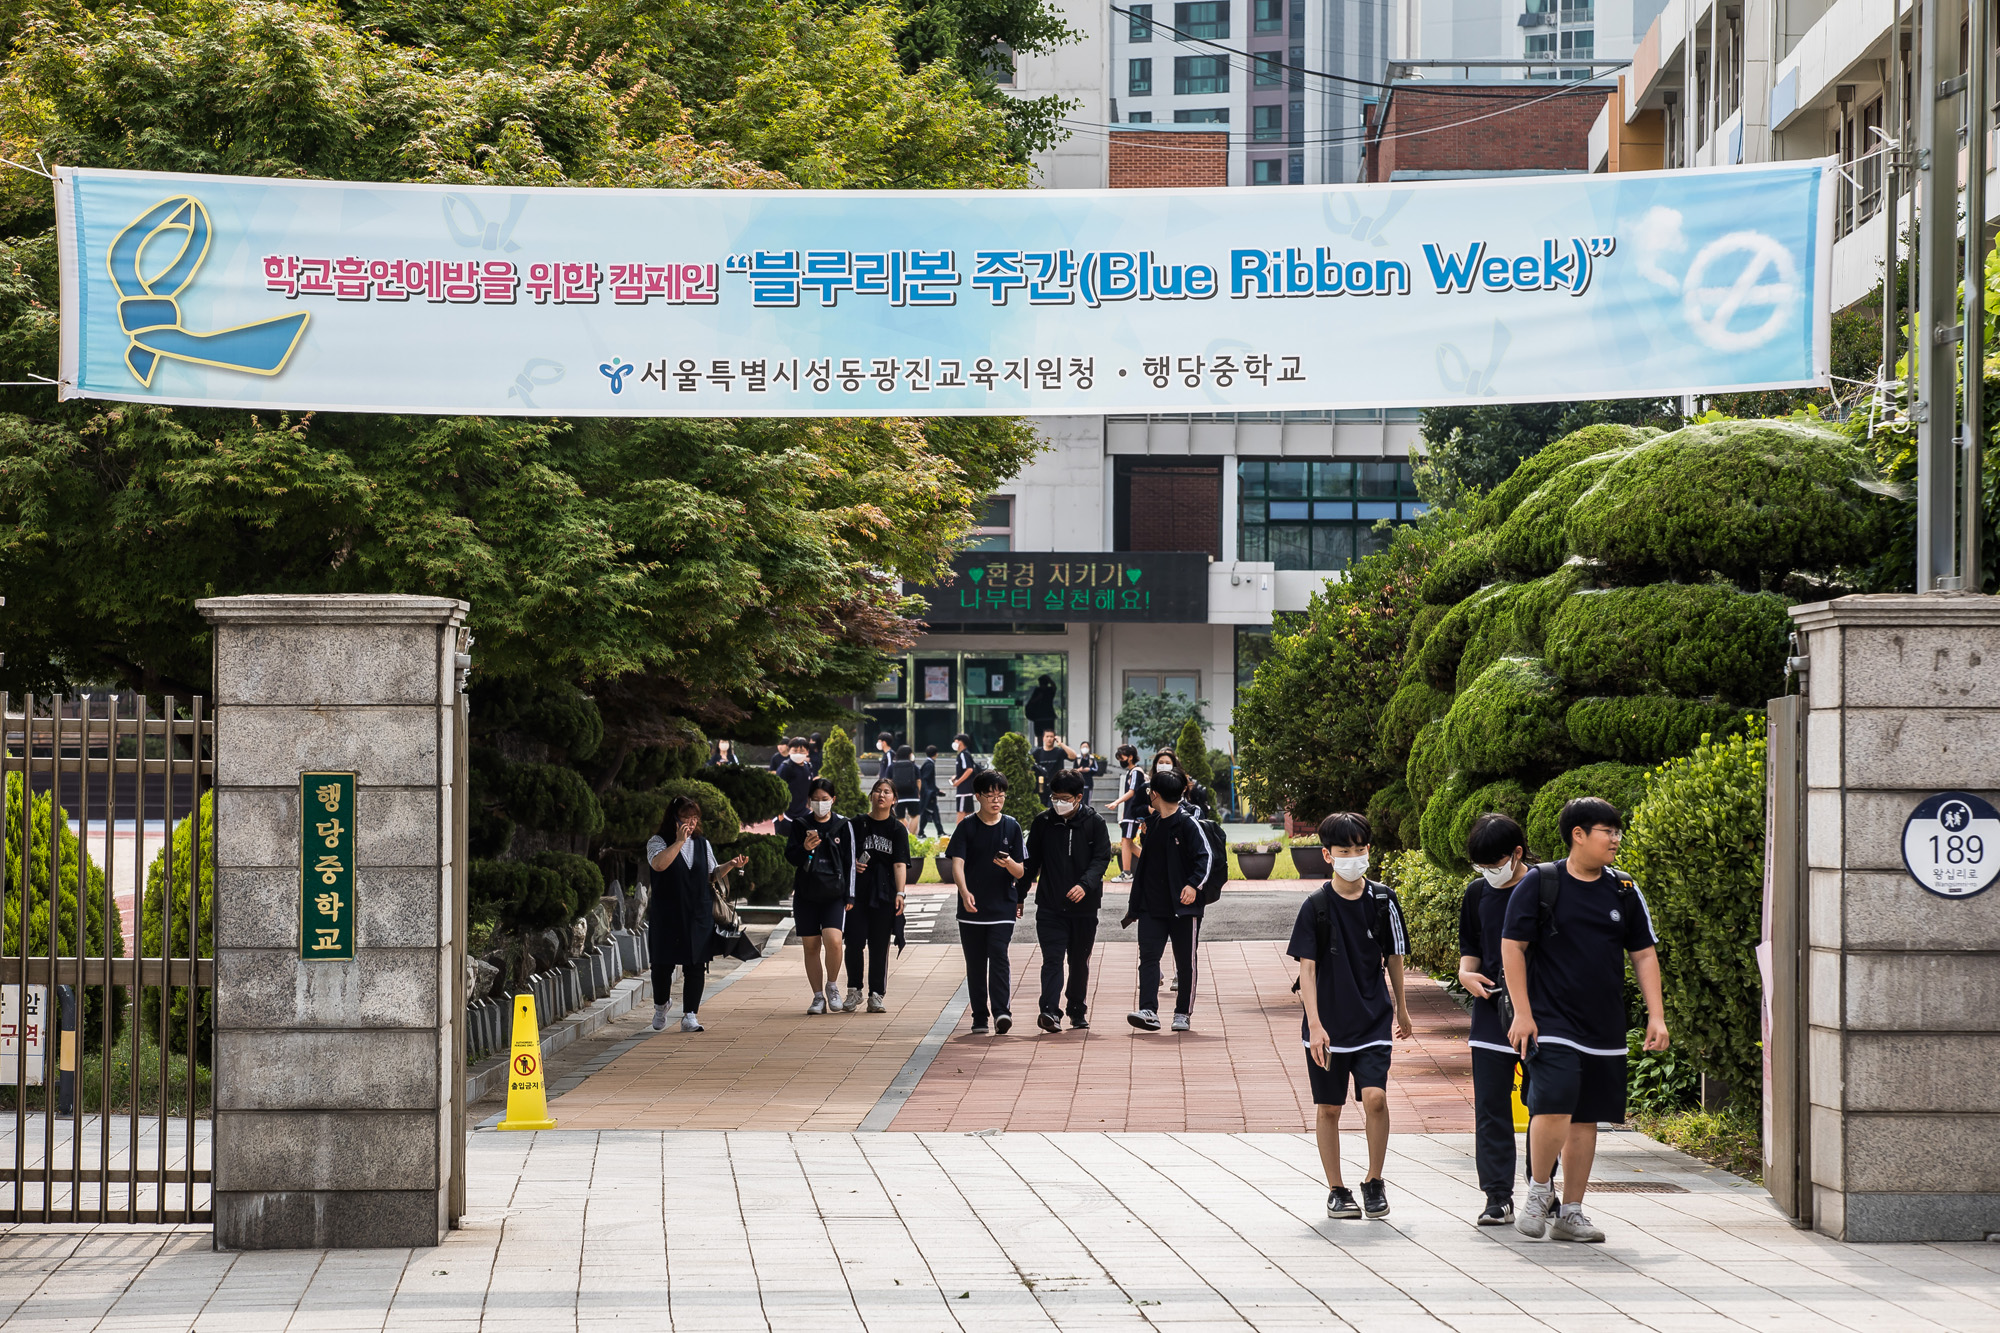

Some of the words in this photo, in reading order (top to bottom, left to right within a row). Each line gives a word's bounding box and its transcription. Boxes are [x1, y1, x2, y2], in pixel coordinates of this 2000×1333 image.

[263, 256, 518, 303] 학교흡연예방을
[527, 260, 601, 303] 위한
[609, 261, 719, 304] 캠페인
[1230, 246, 1410, 298] Ribbon
[640, 358, 1095, 393] 서울특별시성동광진교육지원청
[1142, 354, 1306, 389] 행당중학교
[986, 562, 1034, 587] 환경
[1048, 562, 1123, 587] 지키기
[960, 588, 1031, 610] 나부터
[1043, 588, 1150, 611] 실천해요!
[1929, 835, 1984, 864] 189
[311, 782, 345, 951] 행당중학교
[1933, 868, 1979, 880] 왕십리로
[511, 1081, 539, 1090] 출입금지
